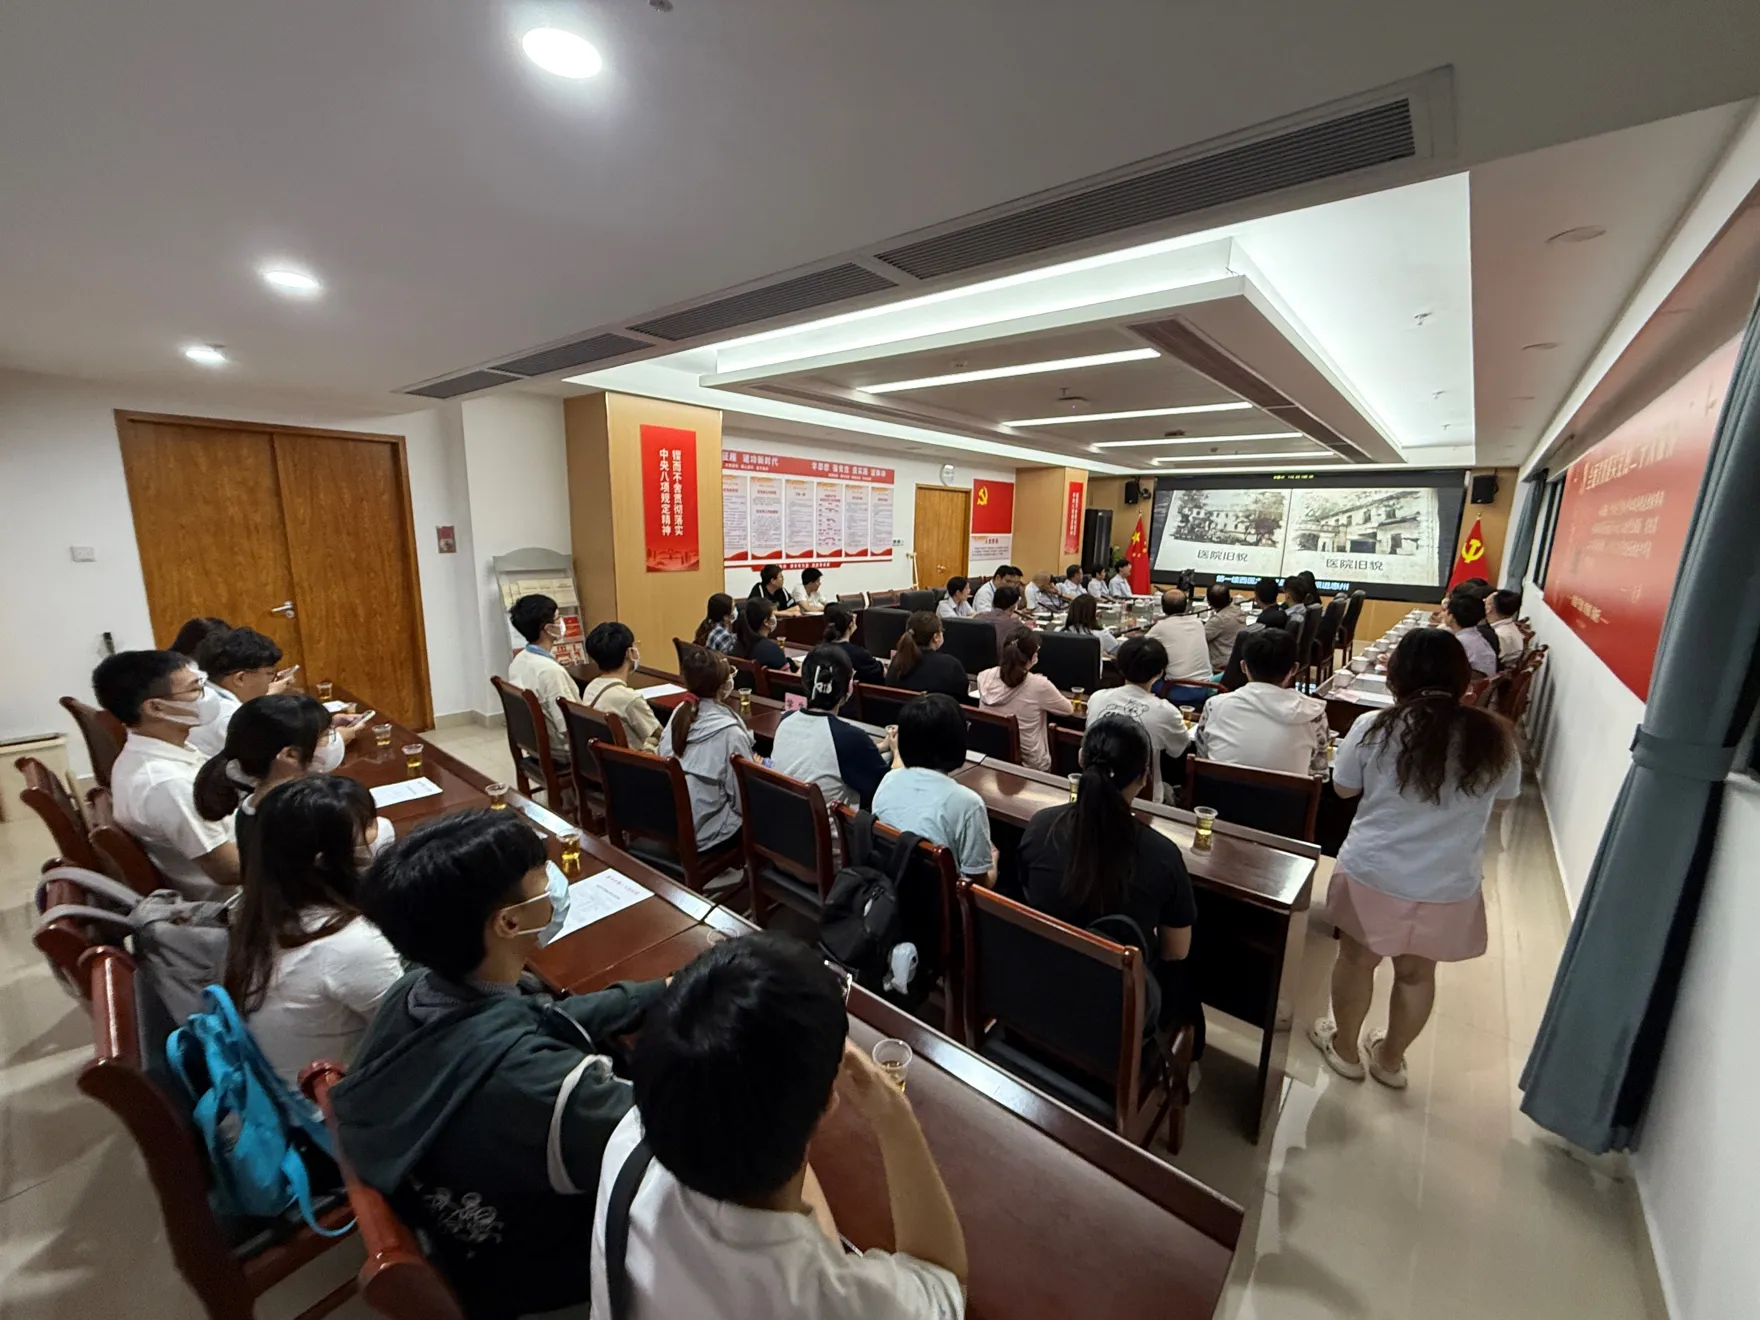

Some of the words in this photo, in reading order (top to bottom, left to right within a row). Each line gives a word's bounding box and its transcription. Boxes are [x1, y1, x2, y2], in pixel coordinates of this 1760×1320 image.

[659, 448, 671, 536] 中央八项规定精神
[672, 449, 684, 536] 锲而不舍贯彻落实
[1197, 549, 1249, 562] 医院旧貌
[1325, 558, 1384, 571] 医院旧貌
